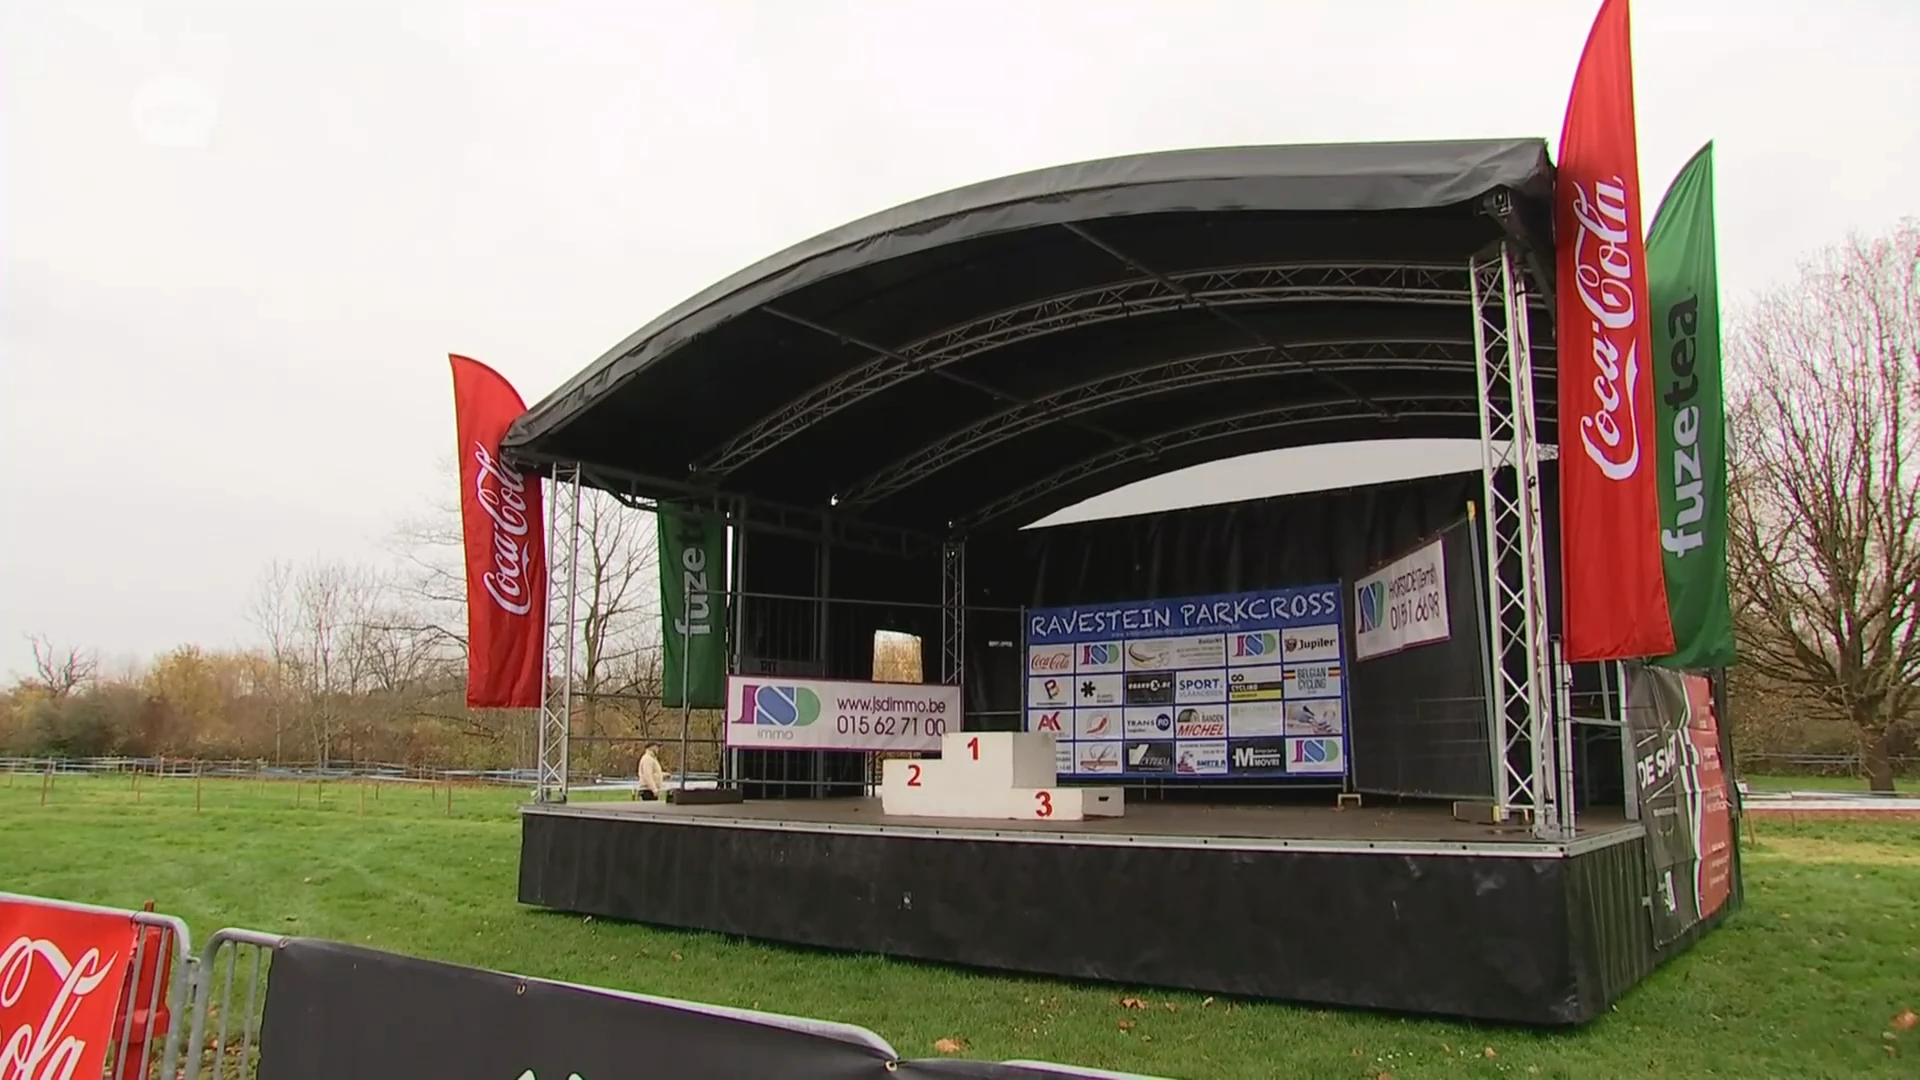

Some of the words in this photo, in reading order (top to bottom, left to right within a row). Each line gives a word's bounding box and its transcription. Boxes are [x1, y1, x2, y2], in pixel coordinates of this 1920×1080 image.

[1572, 175, 1641, 481] Coca-Cola
[1661, 293, 1706, 559] fuzetea
[1031, 606, 1171, 637] RAVESTEIN
[1180, 591, 1336, 626] PARKCROSS
[1299, 637, 1336, 651] Jupiler
[836, 695, 946, 716] www.jsdimmo.be
[757, 728, 794, 741] immo
[836, 714, 870, 736] 015
[874, 716, 896, 736] 62
[896, 716, 918, 736] 71
[925, 718, 946, 737] 00
[1127, 719, 1155, 727] TRANS
[1177, 723, 1225, 737] MICHEL
[967, 737, 979, 761] 1
[907, 764, 921, 787] 2
[1035, 791, 1053, 817] 3
